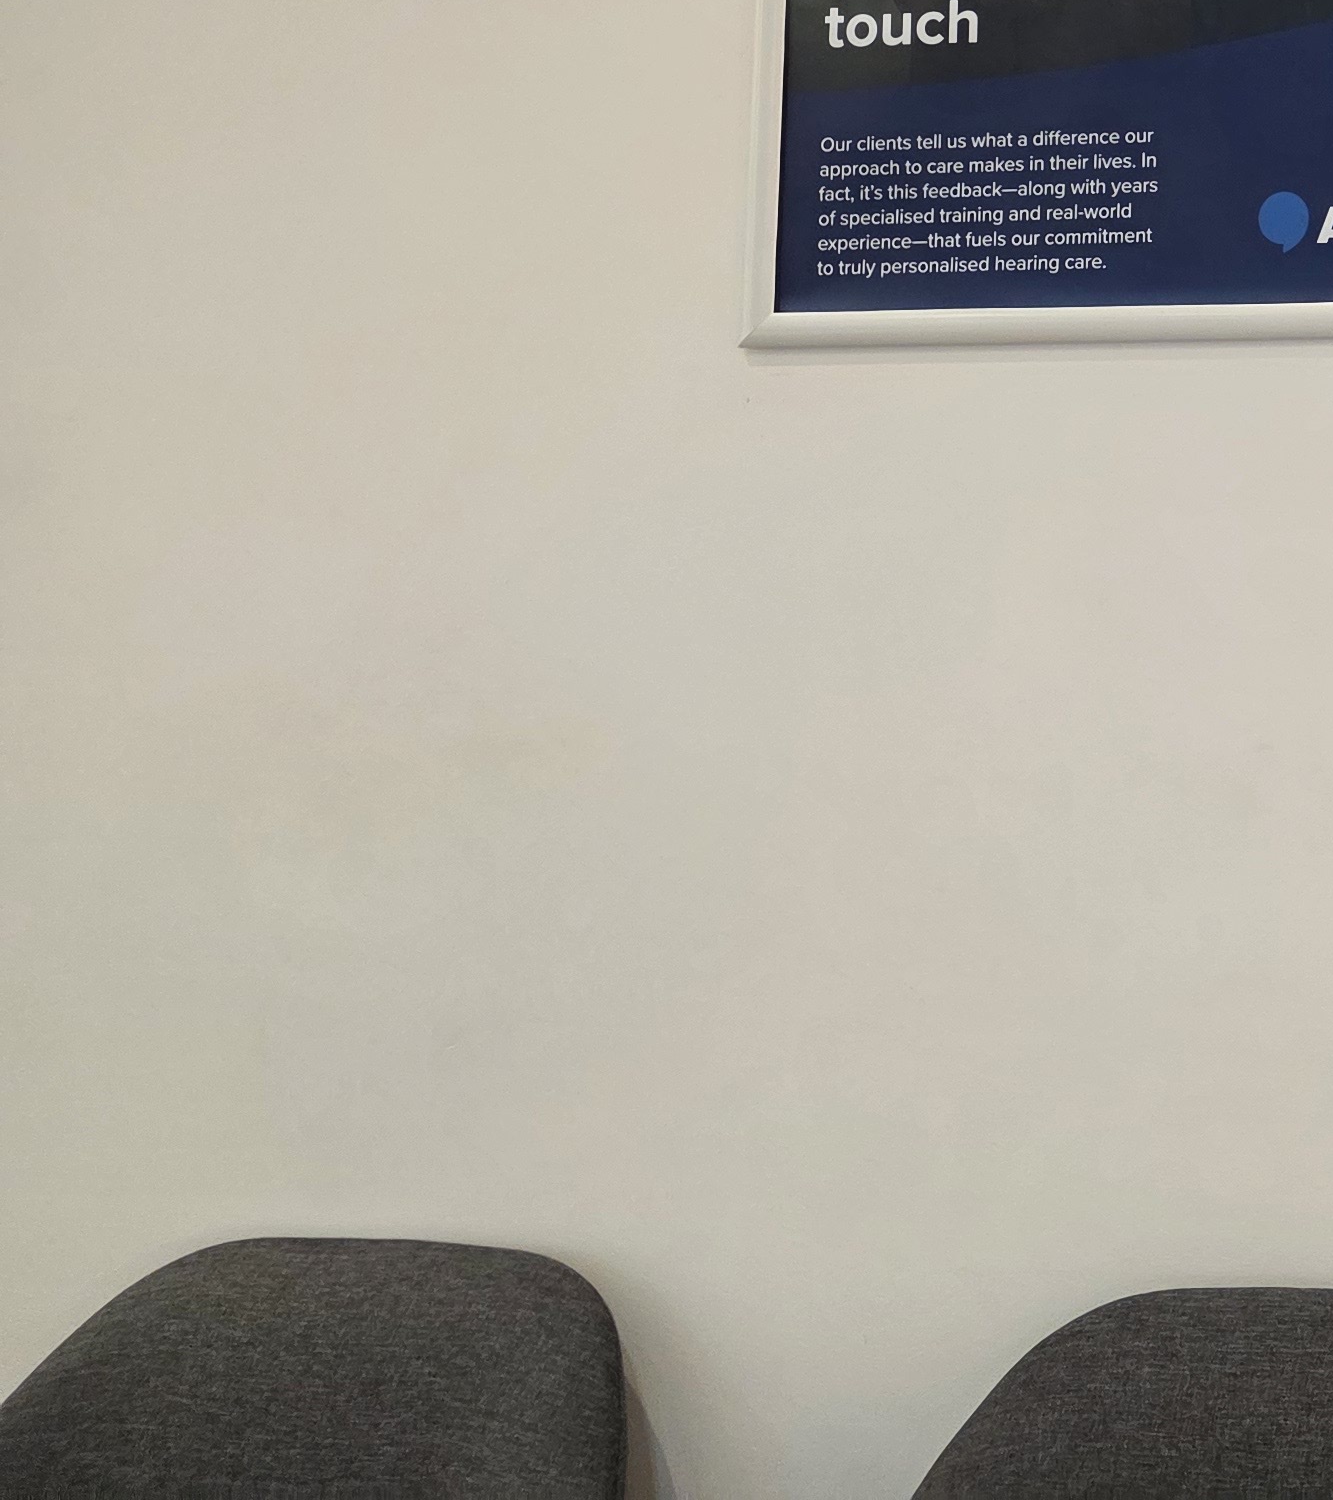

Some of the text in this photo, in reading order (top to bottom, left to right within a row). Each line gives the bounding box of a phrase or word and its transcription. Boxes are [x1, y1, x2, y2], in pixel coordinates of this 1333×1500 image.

[825, 0, 978, 48] touch
[821, 130, 1154, 152] Our clients tell us what a difference our
[820, 152, 1156, 180] approach to care makes in their lives. In
[819, 186, 854, 203] fact,
[887, 184, 918, 200] this
[1071, 178, 1106, 194] with
[1111, 181, 1158, 197] years
[819, 203, 1132, 229] of specialised training and real-world
[965, 231, 1006, 247] fuels
[1011, 234, 1040, 246] our
[1045, 228, 1152, 245] commitment
[817, 255, 1106, 278] to truly personalised hearing care.
